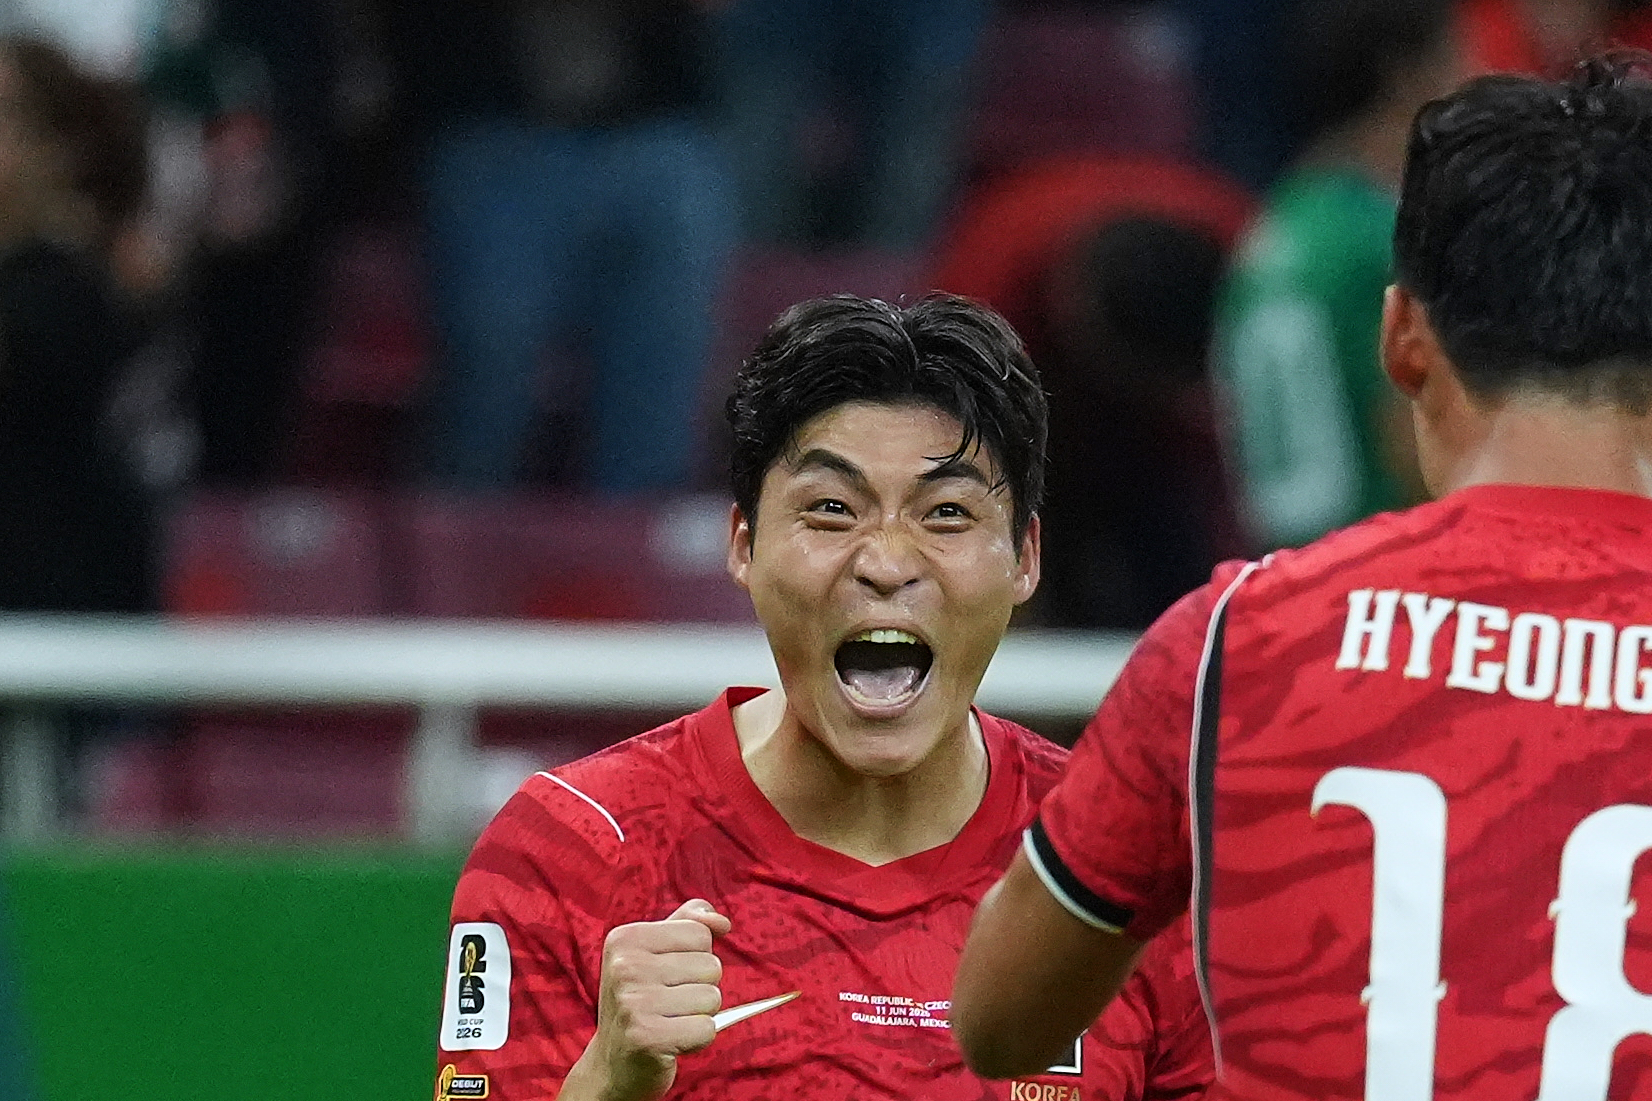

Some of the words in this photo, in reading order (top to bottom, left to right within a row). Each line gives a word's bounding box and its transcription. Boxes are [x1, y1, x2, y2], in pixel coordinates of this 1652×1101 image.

[838, 992, 870, 1003] KOREA
[870, 995, 914, 1006] REPUBLIC
[875, 1006, 886, 1015] 11
[888, 1006, 907, 1016] JUN
[469, 1018, 485, 1026] CUP
[450, 1079, 484, 1089] DEBUT
